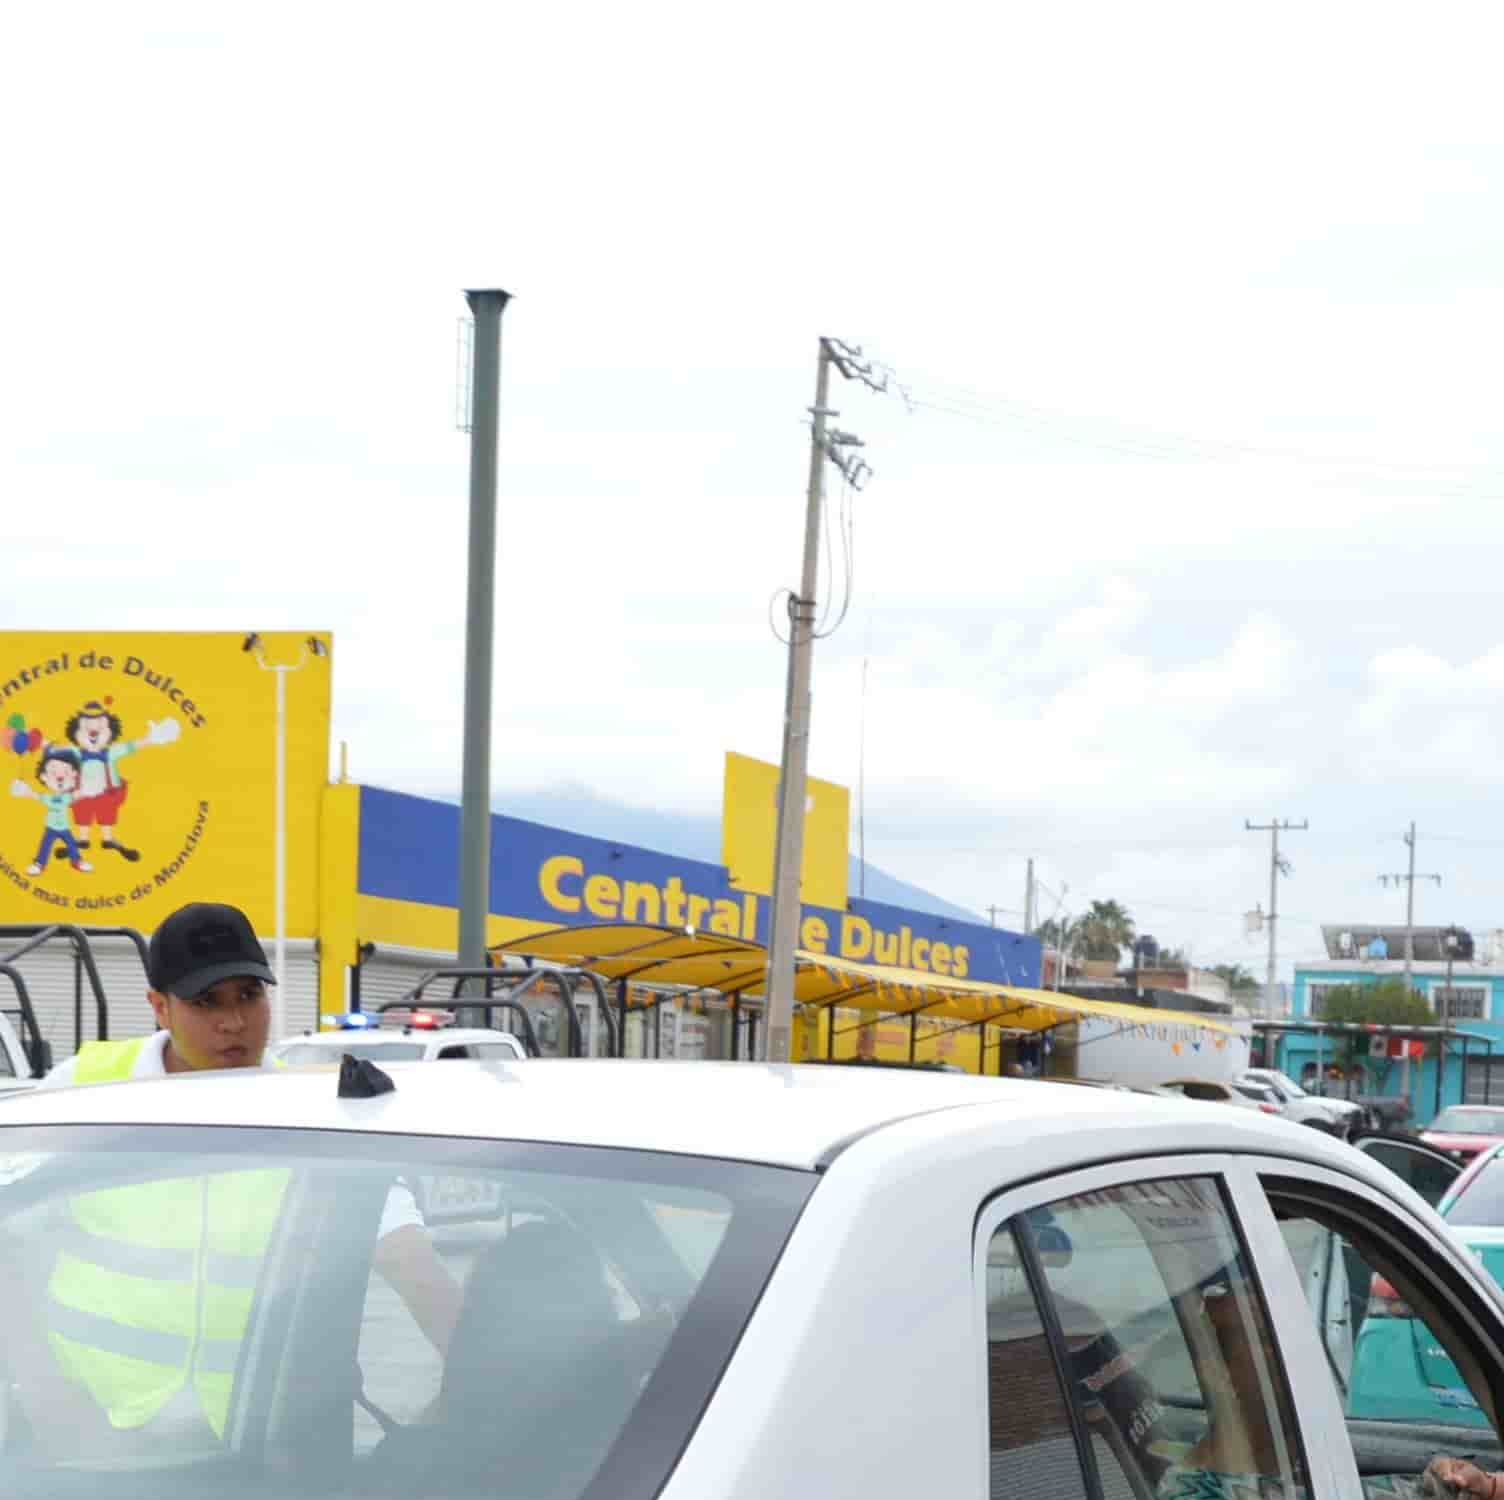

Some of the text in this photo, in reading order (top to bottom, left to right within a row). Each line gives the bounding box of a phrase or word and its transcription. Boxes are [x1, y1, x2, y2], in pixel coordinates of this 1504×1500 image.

[79, 651, 114, 670] de
[123, 656, 207, 729] Dulces
[75, 892, 127, 910] dulce
[130, 881, 154, 902] de
[153, 799, 210, 888] Monclova
[538, 855, 970, 978] Central e Dulces
